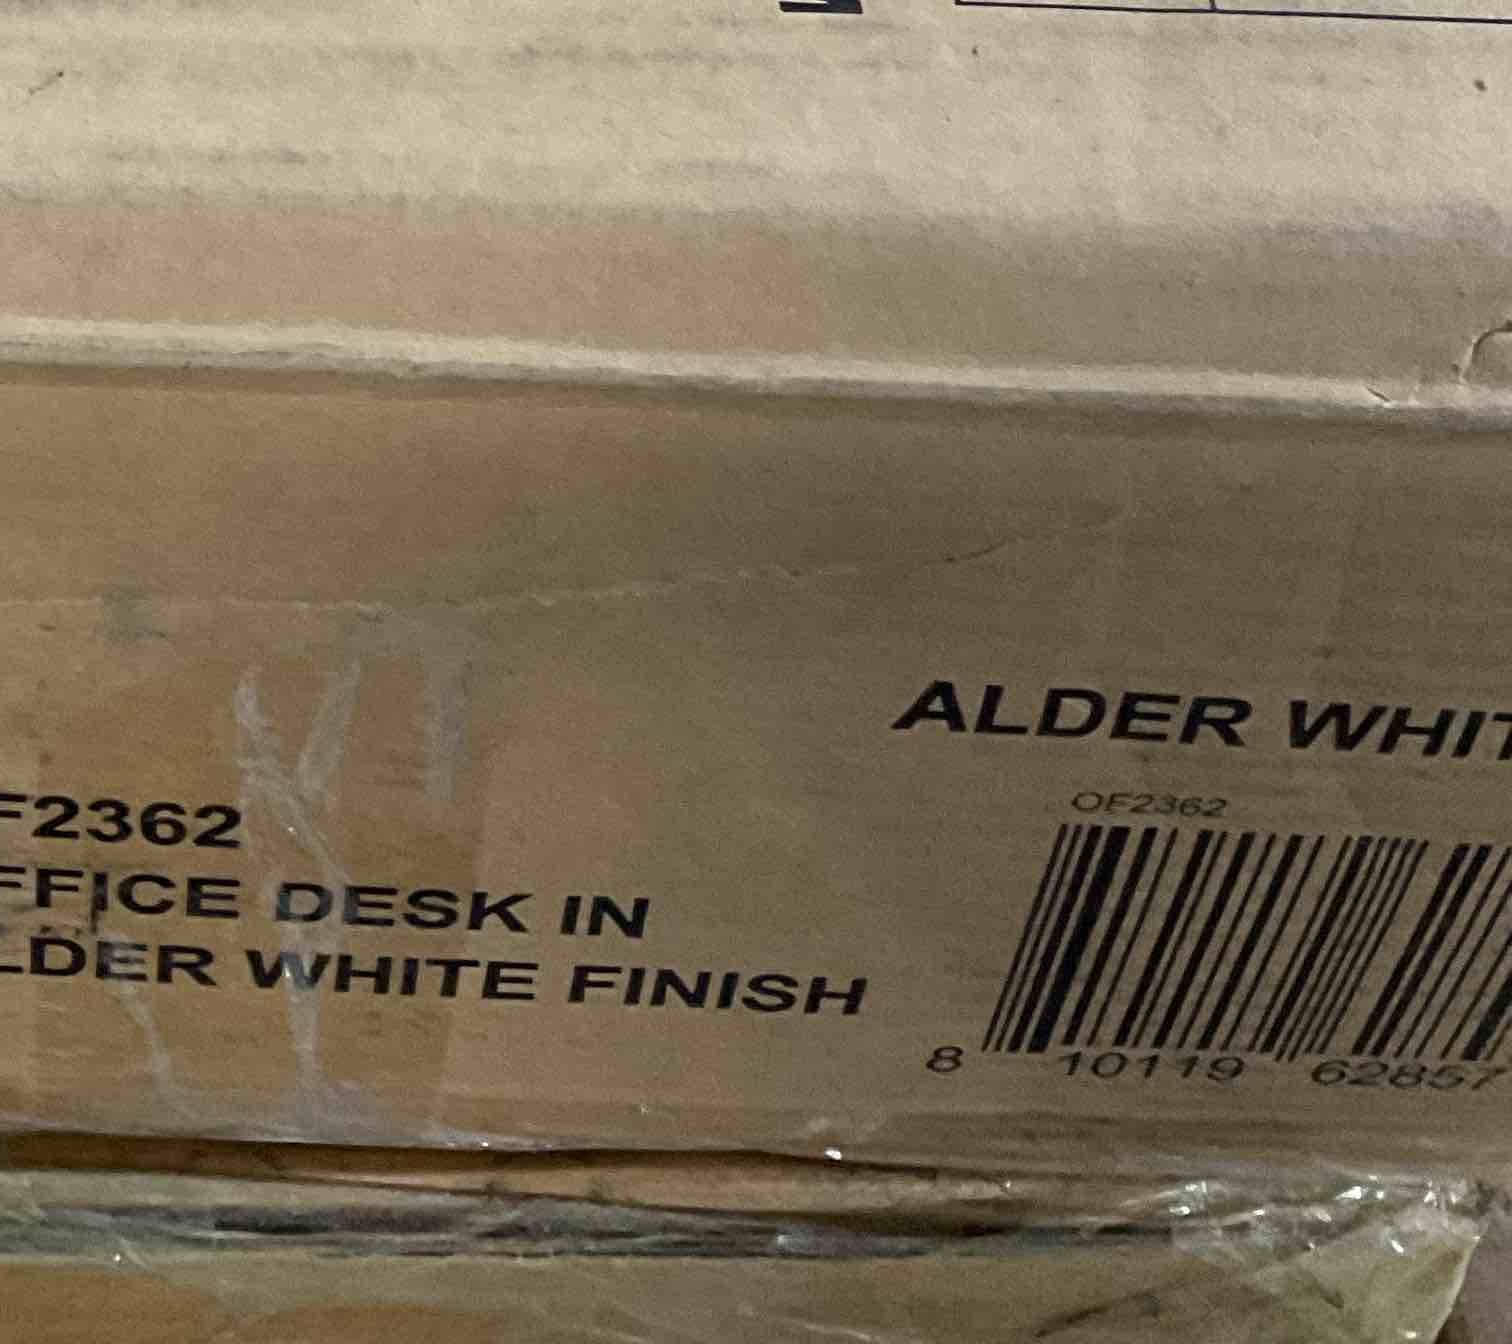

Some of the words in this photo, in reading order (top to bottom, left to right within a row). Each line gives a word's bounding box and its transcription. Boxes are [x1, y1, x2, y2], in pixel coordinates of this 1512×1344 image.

[891, 679, 1253, 747] ALDER
[1071, 791, 1229, 818] OF2362
[274, 882, 530, 935] DESK
[559, 892, 651, 939] IN
[244, 946, 539, 1002] WHITE
[566, 965, 869, 1017] FINISH
[925, 1046, 964, 1074] 8
[1058, 1052, 1246, 1082] 10119
[1311, 1060, 1507, 1091] 62857
